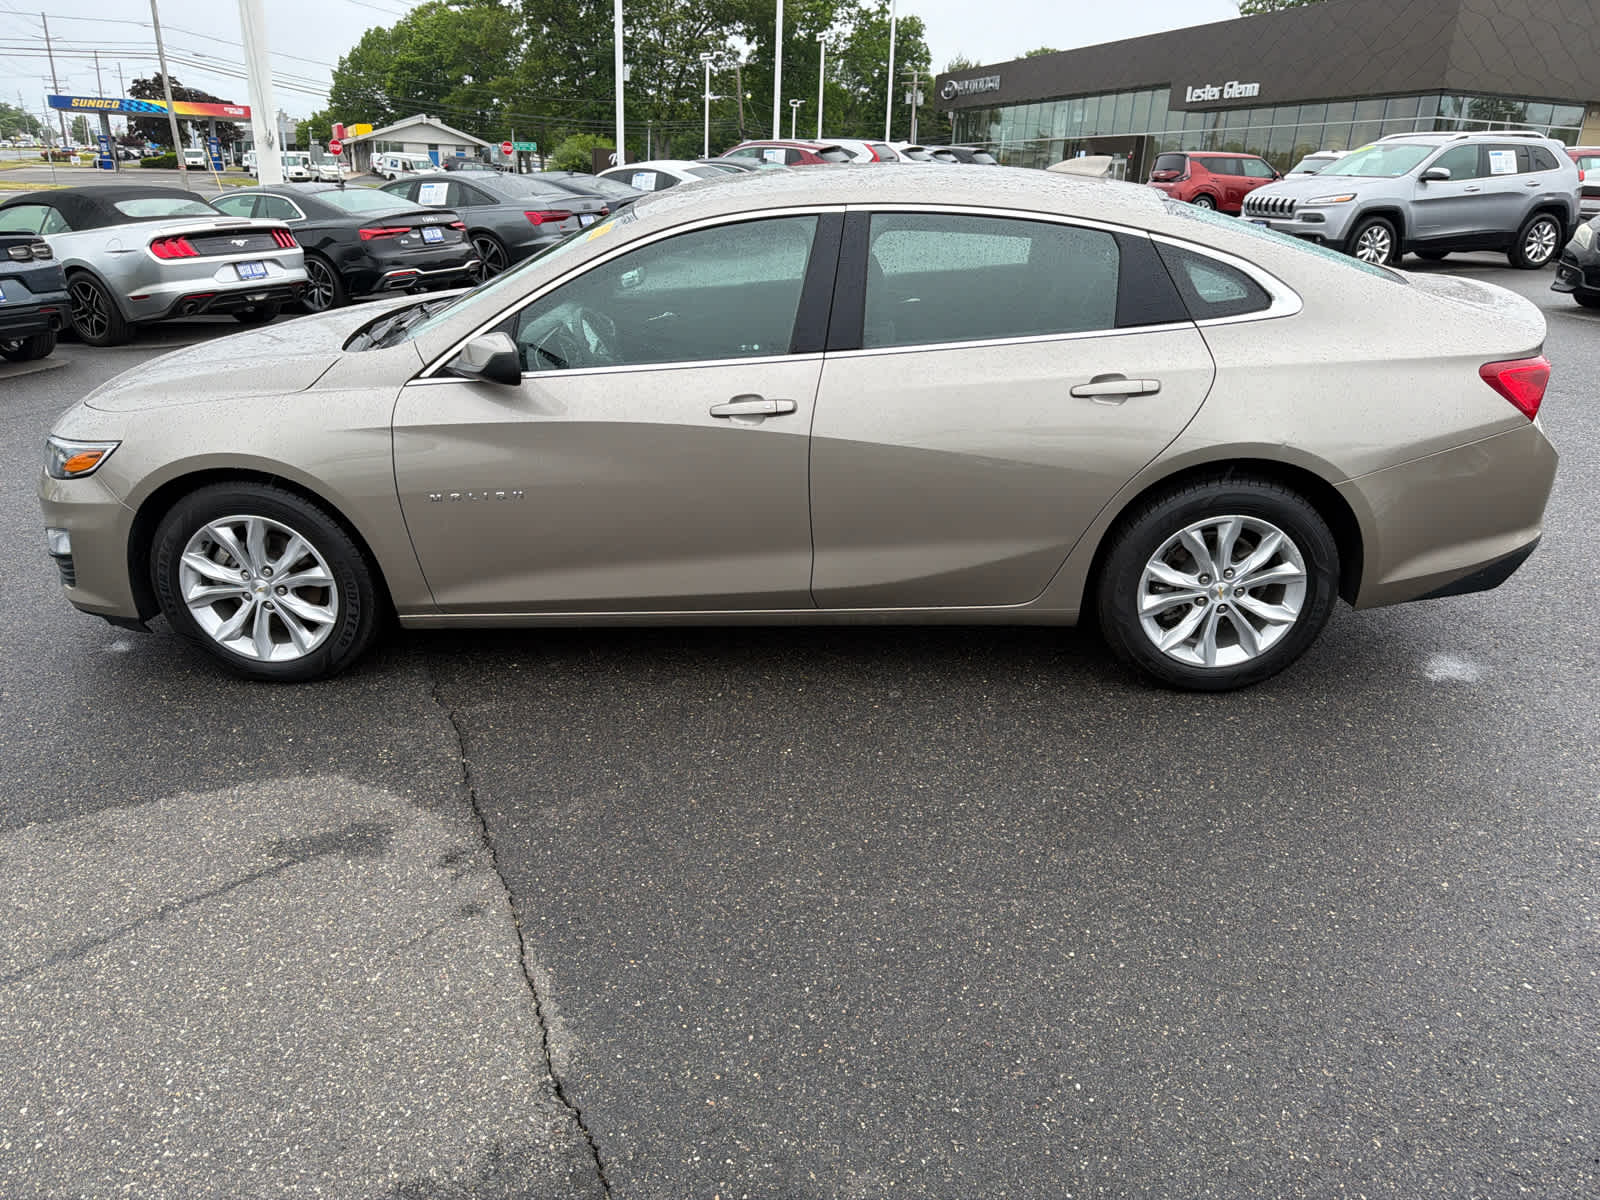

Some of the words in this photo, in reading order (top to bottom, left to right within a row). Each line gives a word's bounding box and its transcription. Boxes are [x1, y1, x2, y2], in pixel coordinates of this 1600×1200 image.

[1185, 84, 1223, 102] Lester
[1223, 81, 1260, 99] Glenn
[71, 98, 121, 109] SUNOCO
